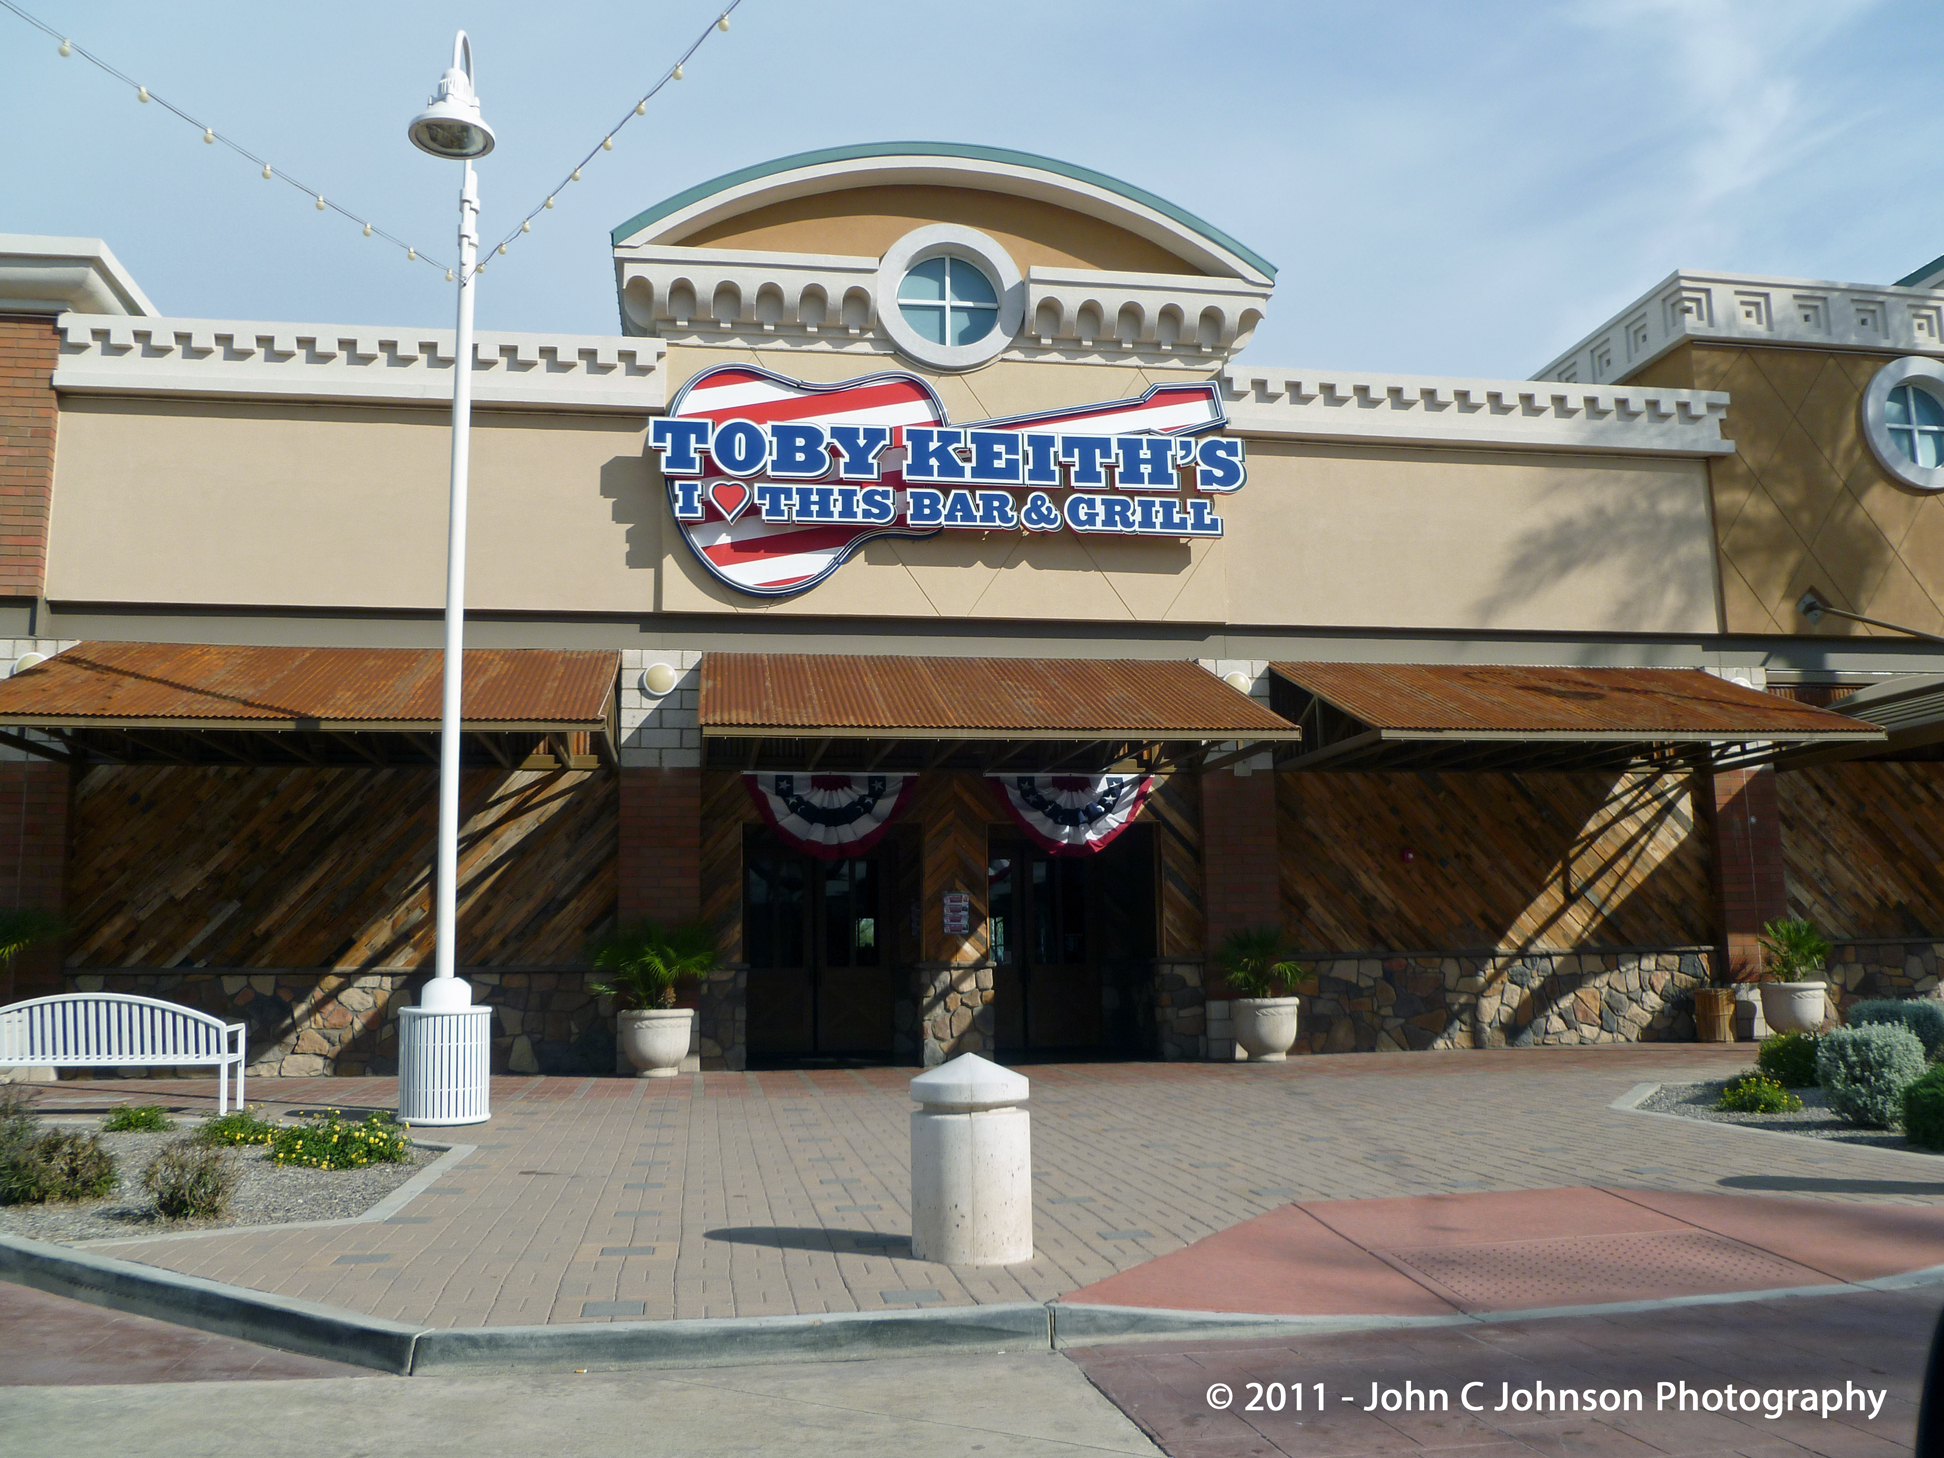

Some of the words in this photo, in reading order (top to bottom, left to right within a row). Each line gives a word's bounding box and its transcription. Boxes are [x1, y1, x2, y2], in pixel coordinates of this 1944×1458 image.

[649, 416, 893, 481] TOBY
[902, 426, 1247, 493] KEITH'S
[674, 480, 705, 520] I
[754, 482, 898, 527] THIS
[907, 488, 1020, 531] BAR
[1021, 491, 1064, 532] &
[1063, 492, 1224, 538] GRILL
